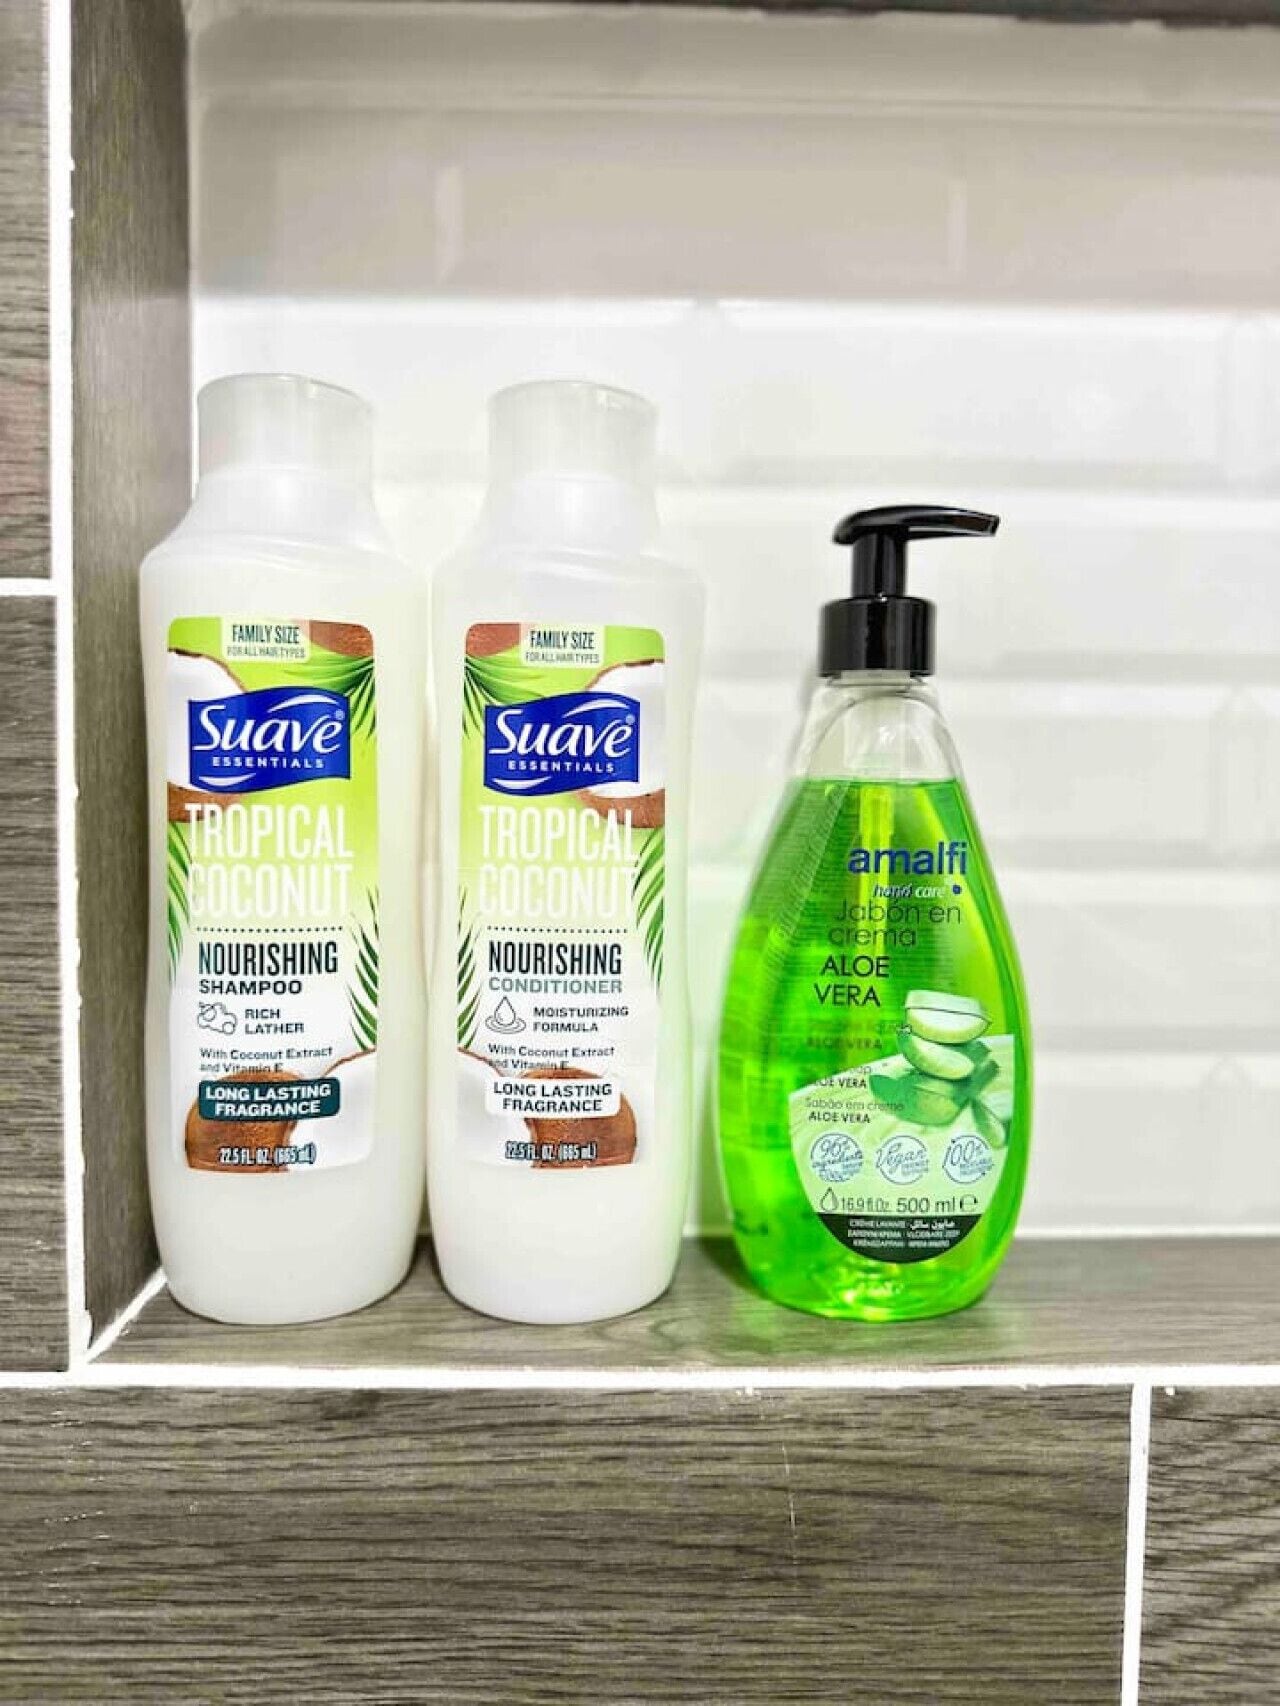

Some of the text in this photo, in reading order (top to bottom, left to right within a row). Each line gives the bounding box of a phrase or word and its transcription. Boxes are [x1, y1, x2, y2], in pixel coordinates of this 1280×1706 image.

[231, 624, 299, 644] FAMILY SIZE
[529, 630, 595, 650] FAMILY SIZE
[280, 647, 305, 659] TYPES
[575, 653, 600, 664] TYPES
[212, 756, 325, 769] ESSENTIALS
[507, 760, 615, 774] ESSENTIALS
[184, 802, 354, 859] TROPICAL
[479, 805, 640, 863] TROPICAL
[847, 841, 968, 876] amalfi
[188, 862, 354, 919] COCONUT
[478, 863, 636, 920] COCONUT
[914, 885, 946, 898] care
[835, 899, 961, 924] Jabón en
[828, 928, 917, 947] crema
[198, 941, 339, 977] NOURISHING
[488, 941, 623, 976] NOURISHING
[820, 955, 890, 978] ALOE
[198, 978, 303, 996] SHAMPOO
[488, 977, 623, 994] CONDITIONER
[813, 983, 881, 1008] VERA
[244, 1008, 280, 1020] RICH
[532, 1005, 629, 1018] MOISTURIZING
[244, 1022, 305, 1035] LATHER
[532, 1021, 599, 1033] FORMULA
[200, 1046, 334, 1061] With Coconut Extract
[488, 1043, 615, 1058] With Coconut Extract
[200, 1062, 220, 1073] and
[223, 1062, 272, 1074] Vitamin
[511, 1059, 558, 1071] Vitamin
[205, 1083, 332, 1101] LONG LASTING
[493, 1082, 613, 1097] LONG LASTING
[214, 1100, 321, 1117] FRAGRANCE
[502, 1098, 603, 1113] FRAGRANCE
[808, 1111, 871, 1124] ALOE VERA
[896, 1197, 930, 1213] 500
[934, 1195, 956, 1213] ml
